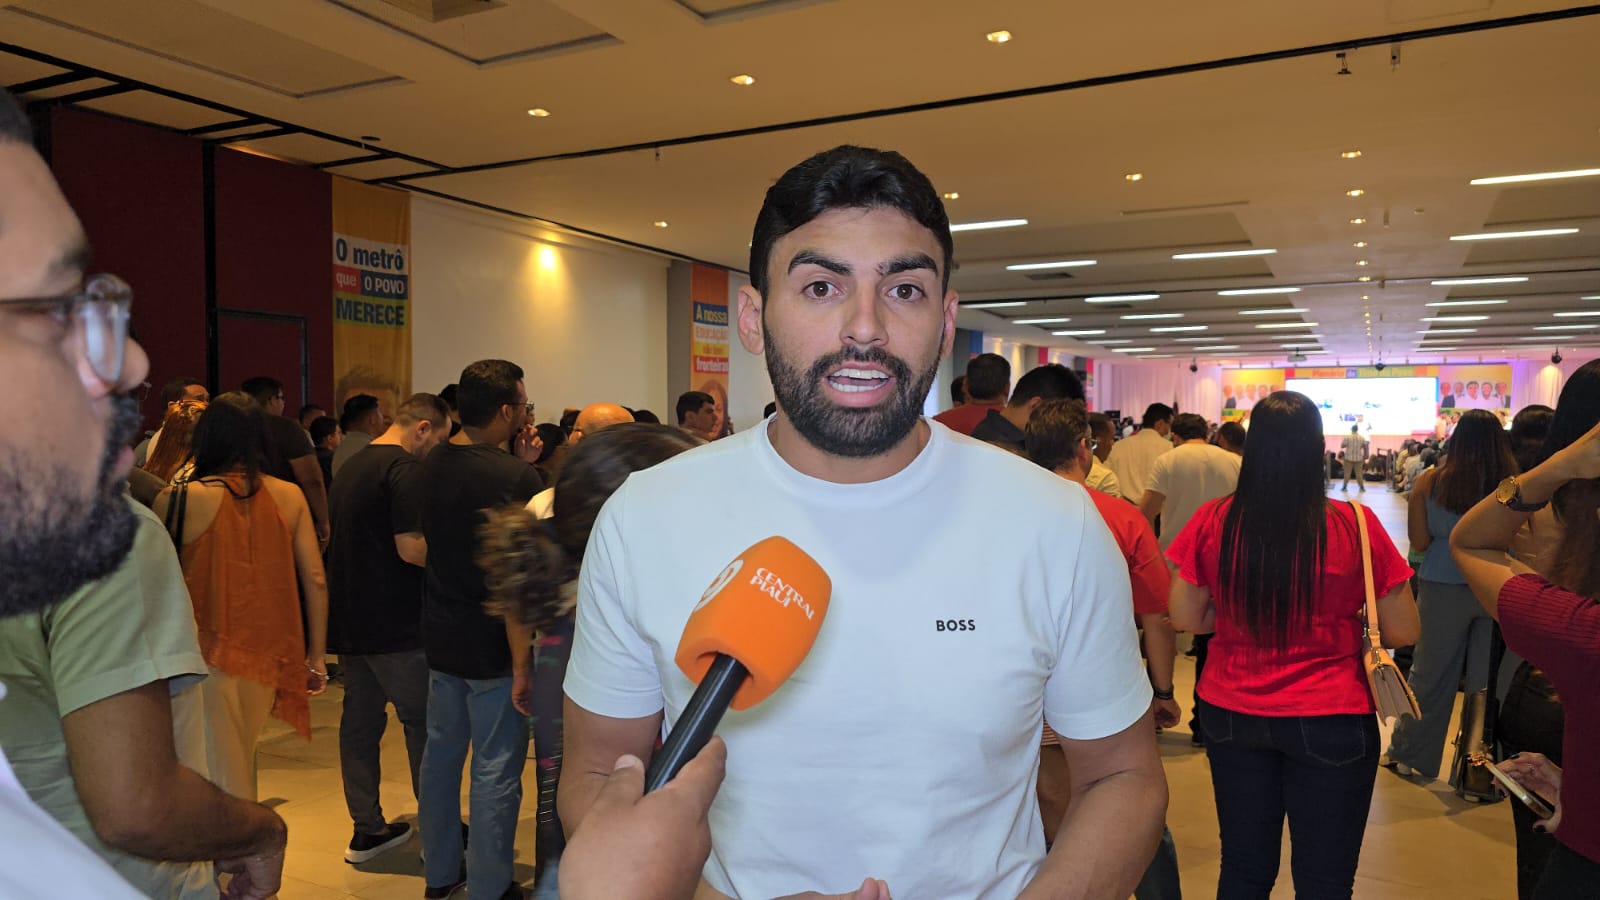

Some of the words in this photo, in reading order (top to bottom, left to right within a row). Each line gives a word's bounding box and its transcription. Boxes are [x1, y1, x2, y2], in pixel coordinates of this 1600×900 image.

[336, 238, 348, 261] O
[353, 247, 403, 270] metrô
[335, 272, 357, 288] que
[364, 276, 373, 291] O
[375, 278, 404, 294] POVO
[336, 297, 404, 326] MERECE
[696, 303, 702, 321] A
[703, 309, 728, 323] nossa
[936, 619, 976, 632] BOSS
